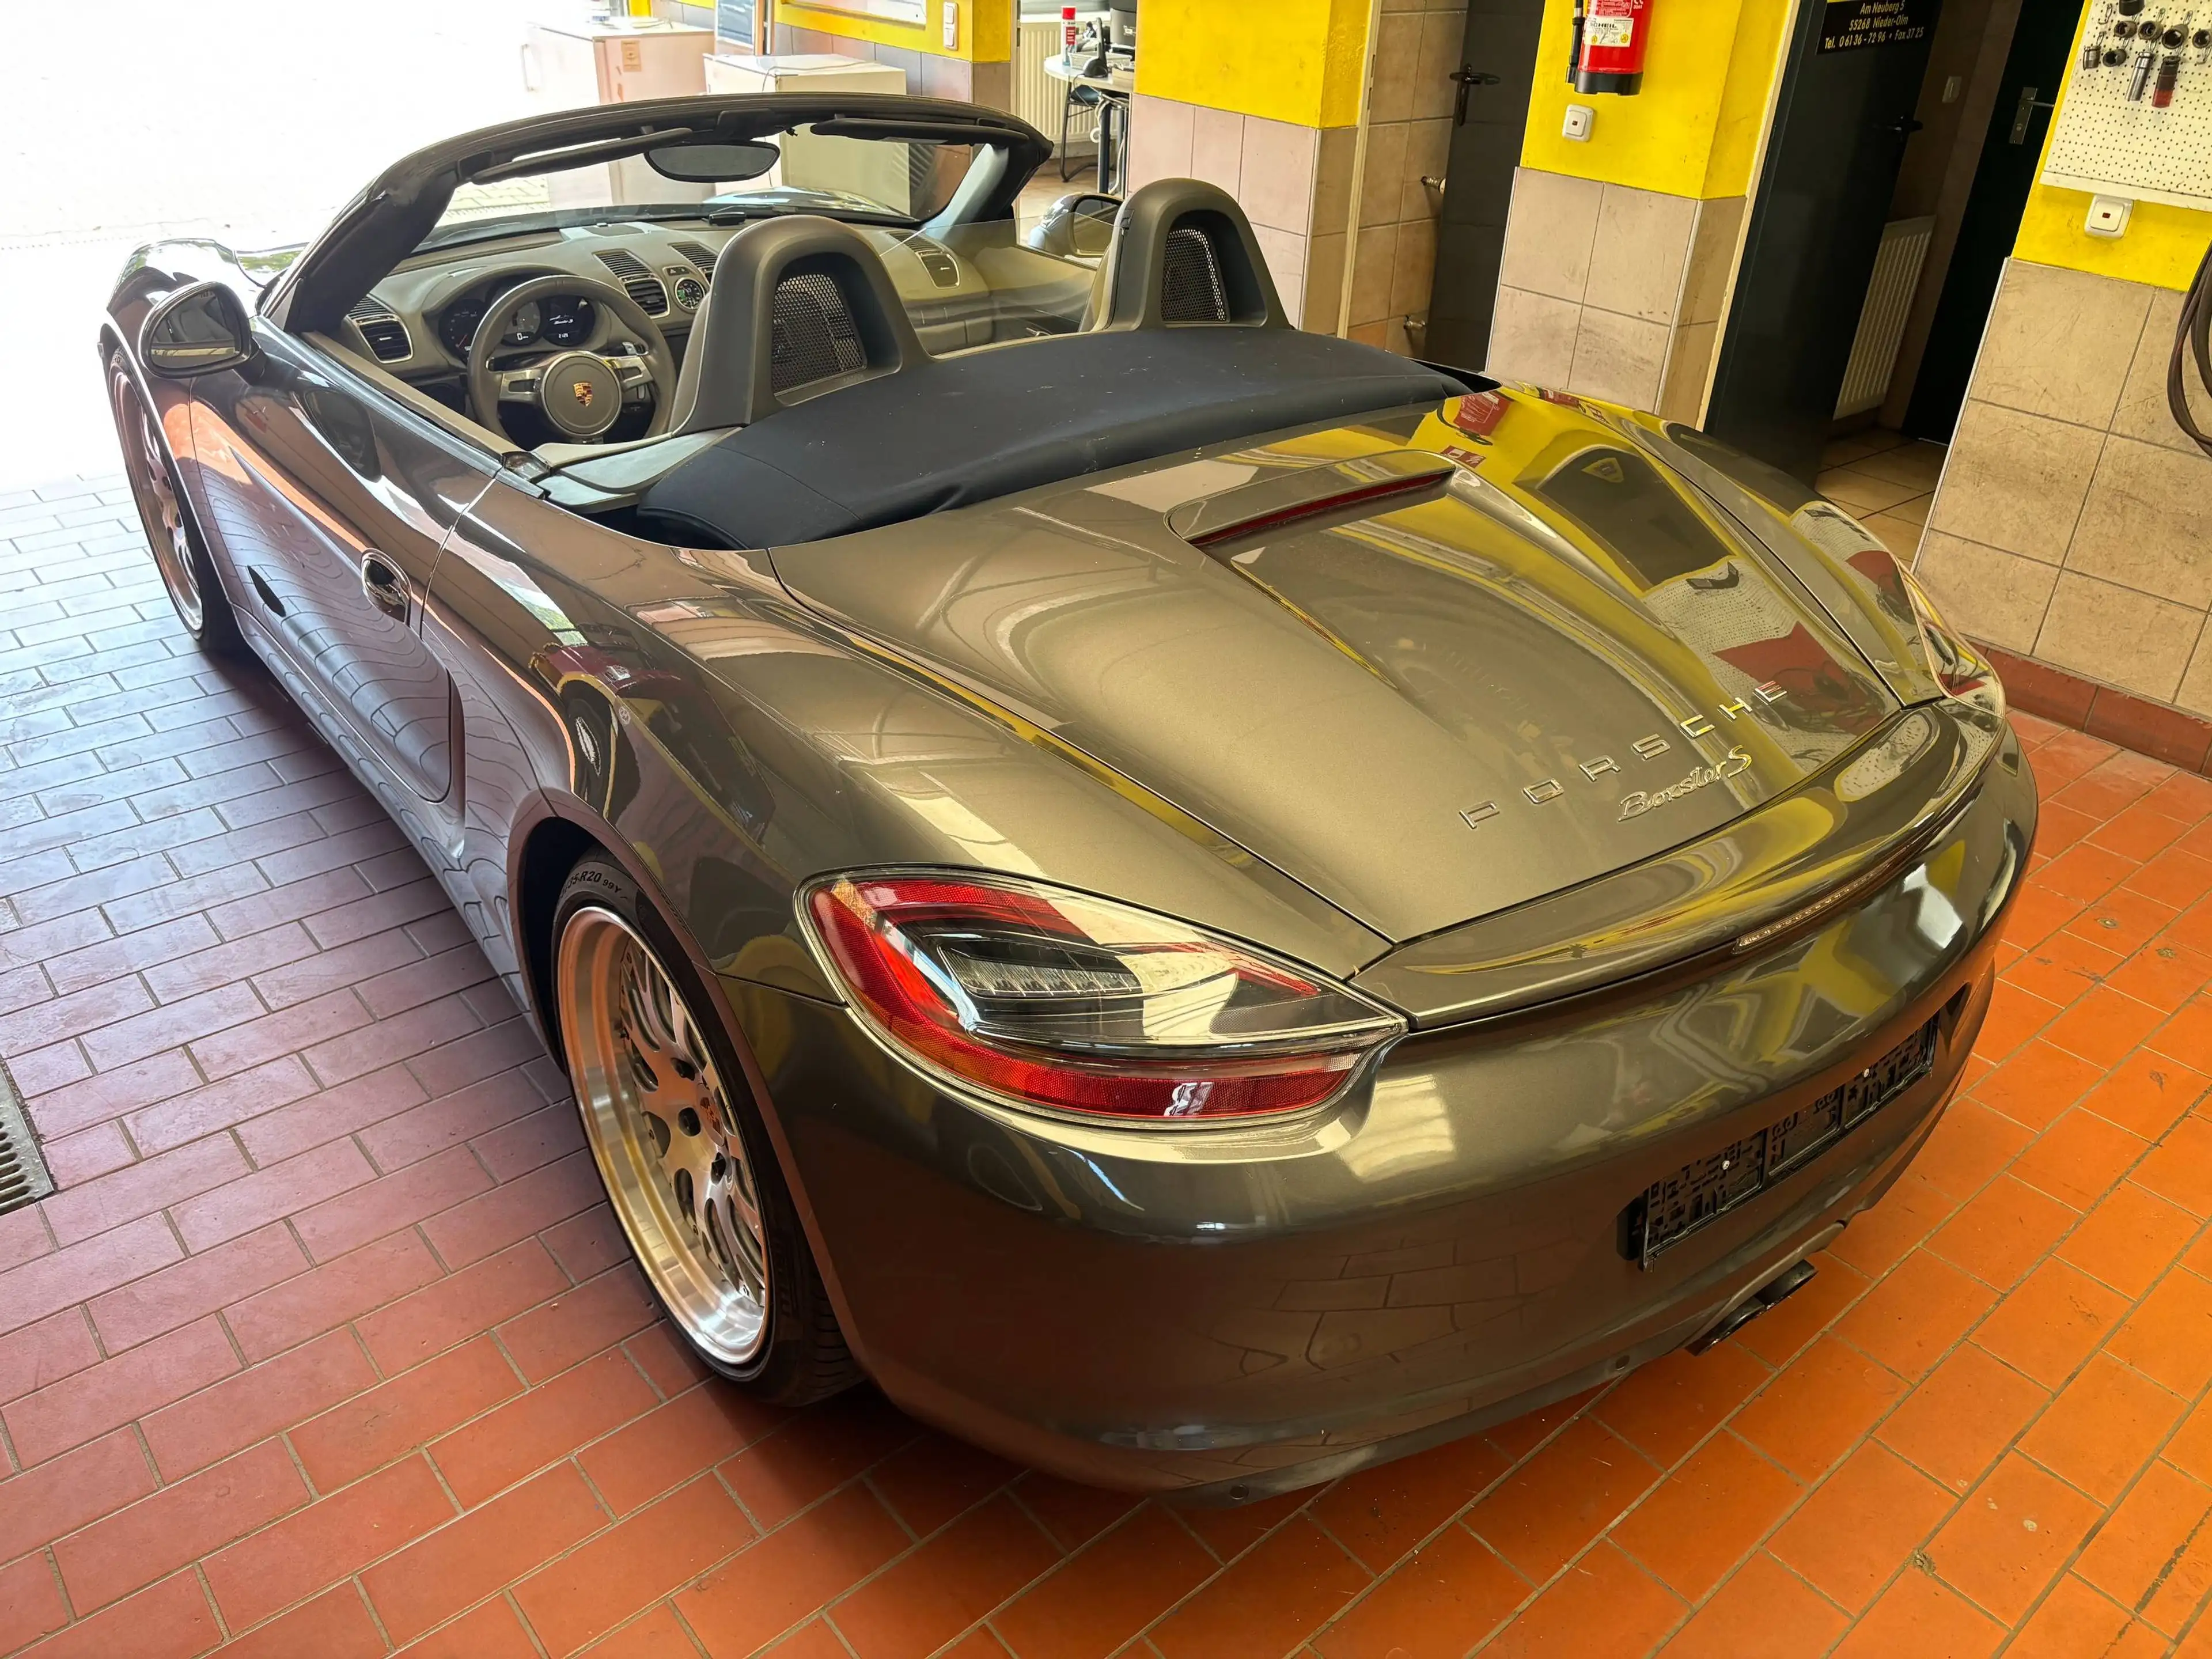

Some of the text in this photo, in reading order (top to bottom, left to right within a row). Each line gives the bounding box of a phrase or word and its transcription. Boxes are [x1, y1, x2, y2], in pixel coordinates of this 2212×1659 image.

[1860, 0, 1905, 15] Am Neuberg 5
[1849, 14, 1908, 32] 55268 Nieder-Olm
[1825, 36, 1836, 50] Tel.
[1895, 30, 1907, 41] Fax
[1459, 680, 1787, 830] PORSCHE
[1618, 744, 1752, 823] Boxster S
